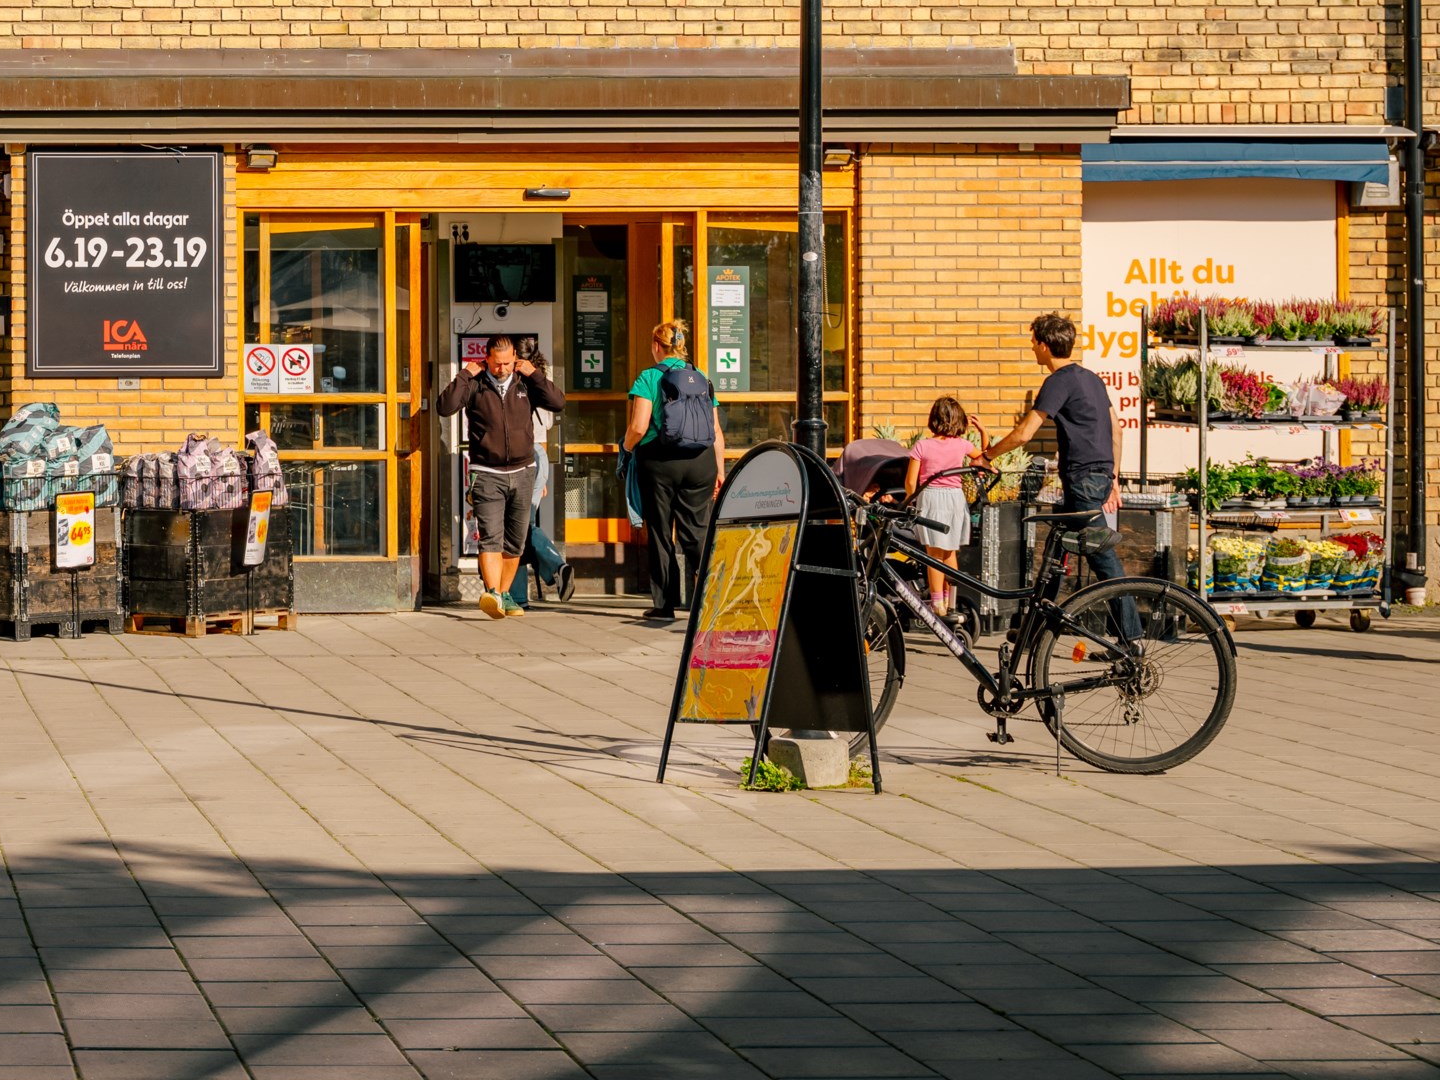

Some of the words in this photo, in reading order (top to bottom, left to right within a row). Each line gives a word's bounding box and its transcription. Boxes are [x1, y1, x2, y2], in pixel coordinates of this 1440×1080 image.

[62, 209, 110, 228] Öppet
[112, 212, 140, 226] alla
[143, 212, 189, 228] dagar
[1124, 258, 1184, 284] Allt
[1192, 258, 1235, 284] du
[64, 281, 130, 294] Välkommen
[133, 281, 144, 291] in
[148, 278, 164, 290] till
[167, 277, 188, 290] oss!
[104, 320, 148, 343] ICA
[124, 342, 148, 350] nära
[1097, 372, 1123, 390] älj
